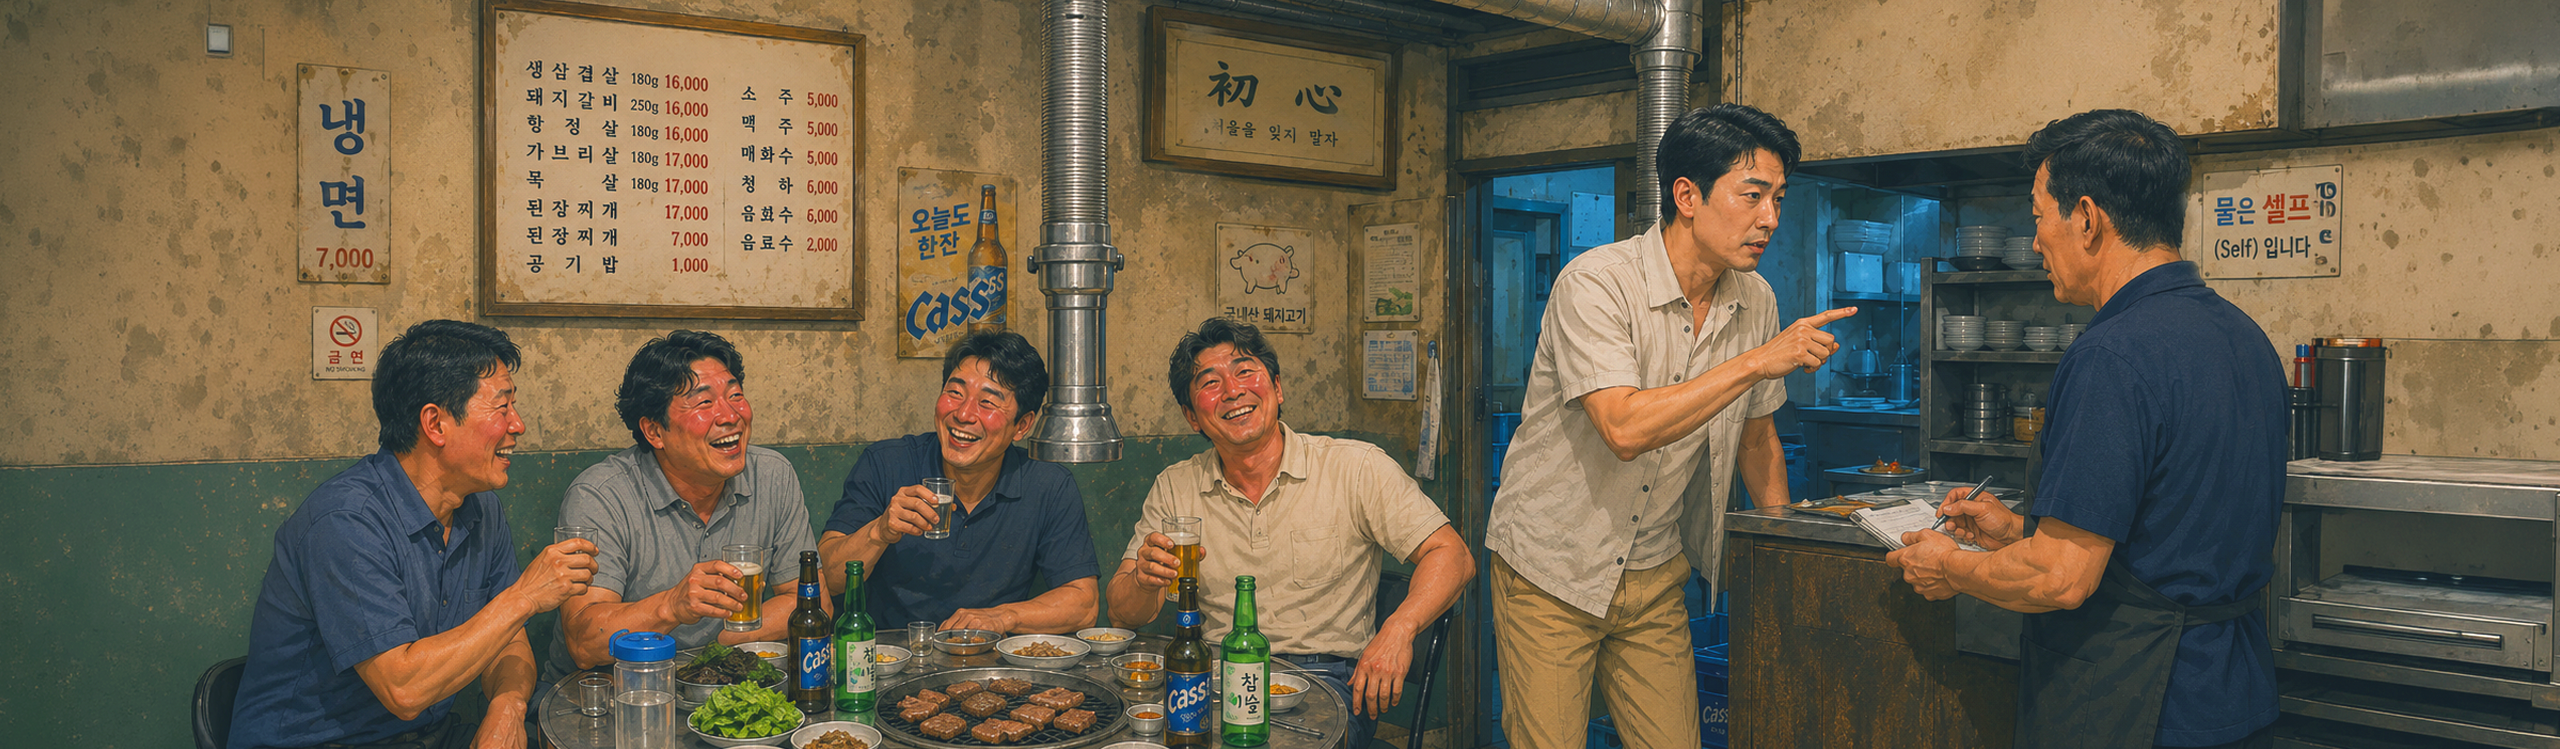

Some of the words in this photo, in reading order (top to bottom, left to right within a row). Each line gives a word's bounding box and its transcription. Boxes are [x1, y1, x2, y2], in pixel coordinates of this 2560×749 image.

[632, 73, 658, 88] 180g
[665, 75, 708, 91] 16,000
[631, 99, 658, 114] 250g
[665, 101, 708, 117] 16,000
[808, 92, 838, 108] 5,000
[632, 125, 658, 140] 180g
[665, 126, 708, 143] 16,000
[808, 122, 837, 137] 5,000
[1269, 125, 1295, 143] 잊지
[1310, 129, 1338, 147] 말자
[319, 98, 366, 229] 냉면
[632, 151, 658, 166] 180g
[665, 152, 708, 168] 17,000
[807, 151, 837, 166] 5,000
[632, 178, 658, 193] 180g
[665, 178, 708, 195] 17,000
[808, 180, 837, 195] 6,000
[666, 205, 708, 221] 17,000
[807, 209, 837, 224] 6,000
[910, 203, 970, 233] 오늘도
[2214, 197, 2255, 226] 물은
[2263, 194, 2311, 224] 셀프
[672, 232, 708, 247] 7,000
[807, 238, 837, 252] 2,000
[918, 231, 960, 260] 한잔
[2215, 238, 2258, 260] (Self)
[2264, 236, 2311, 259] 입니다
[317, 248, 373, 270] 7,000
[673, 258, 708, 273] 1,000
[906, 282, 990, 340] Cass
[1264, 308, 1305, 324] 돼지고기
[1167, 681, 1207, 714] Cass
